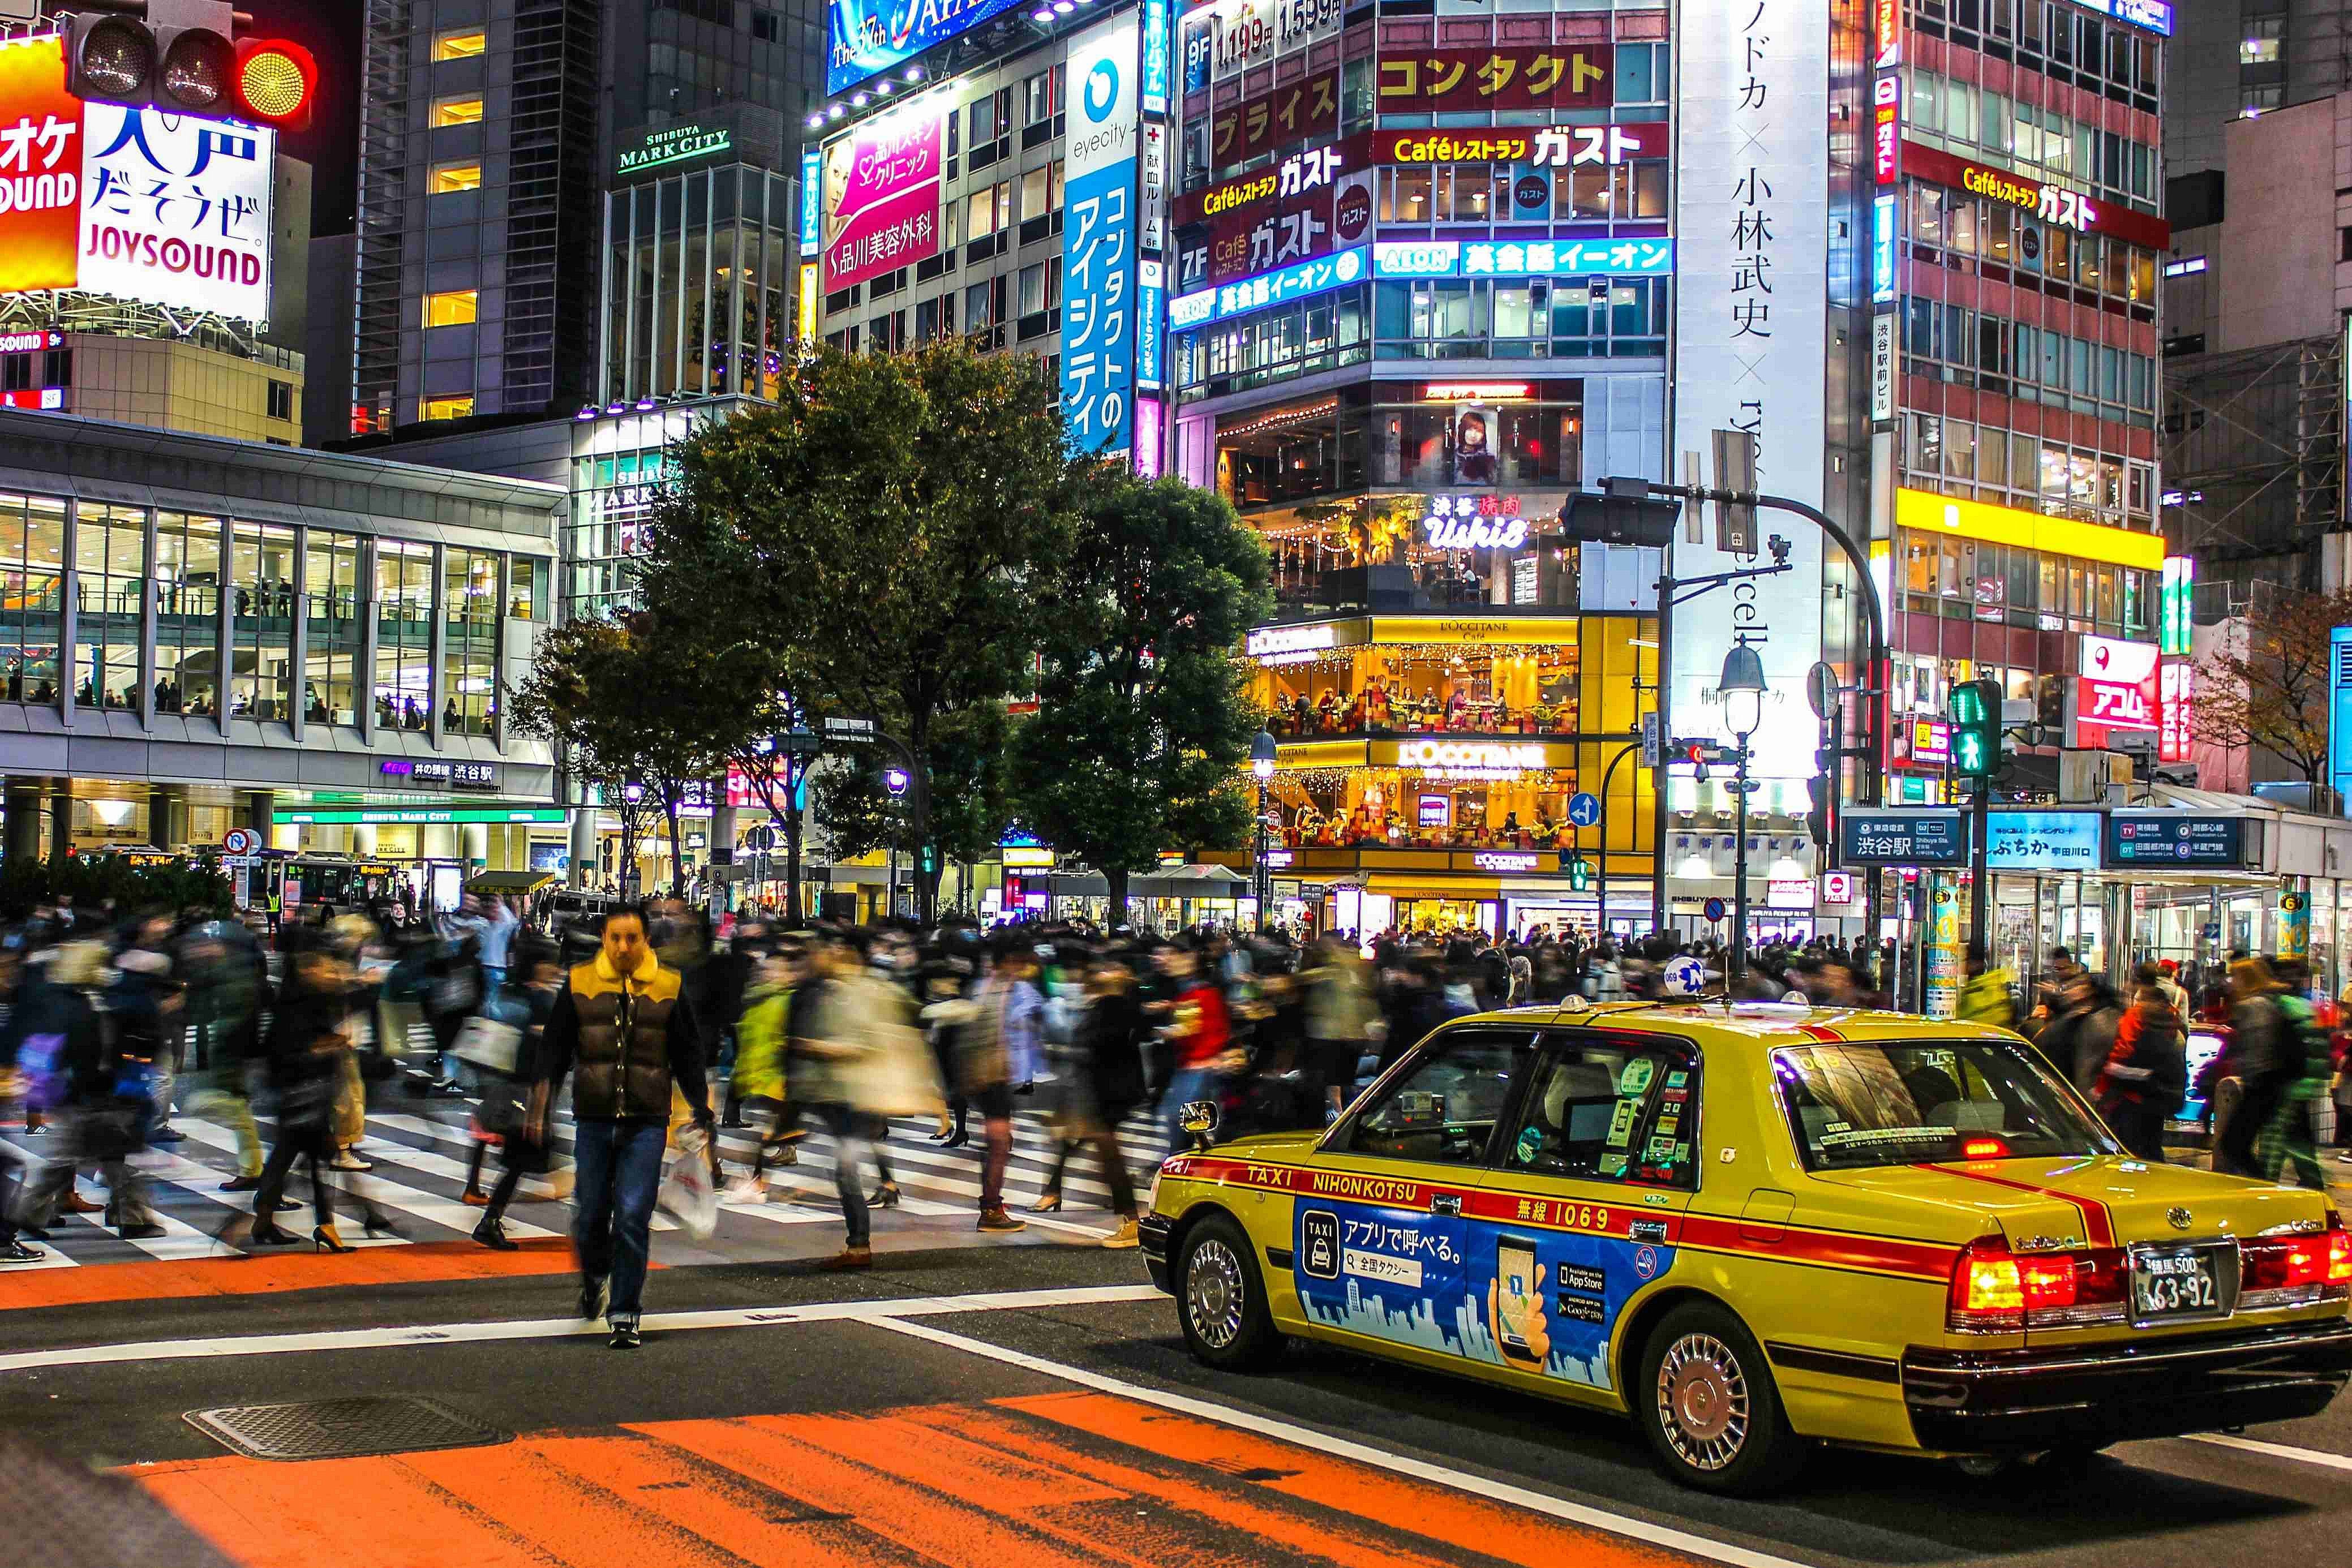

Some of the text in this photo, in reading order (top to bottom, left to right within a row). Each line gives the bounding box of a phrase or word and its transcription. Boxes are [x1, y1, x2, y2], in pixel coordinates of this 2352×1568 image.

[834, 44, 857, 68] The
[856, 15, 886, 55] 37th
[1188, 36, 1210, 66] 9F
[1380, 53, 1605, 97] コンタクト
[1216, 77, 1336, 155] プライス
[0, 115, 76, 172] オケ
[620, 130, 728, 169] MARK CITY
[646, 125, 699, 145] SHIBUYA
[1074, 123, 1126, 161] eyecity
[1533, 126, 1641, 167] ガスト
[1878, 122, 1892, 175] ガスト
[875, 148, 928, 190] クリニック
[1280, 144, 1342, 199] ガスト
[90, 166, 263, 247] だそうぜ。
[1146, 154, 1160, 233] 献血ルーム
[1519, 190, 1544, 200] ガスト
[2038, 184, 2096, 233] ガスト
[1342, 208, 1367, 226] ガスト
[87, 224, 261, 286] JOYSOUND
[840, 210, 933, 276] 品川美容外科
[1146, 238, 1157, 247] 6F
[1216, 234, 1247, 261] Café
[1250, 209, 1325, 273] ガスト
[1730, 167, 1772, 338] 小林武史
[1182, 247, 1208, 281] 7F
[1215, 259, 1246, 277] レストラン
[1384, 248, 1448, 269] AEON
[1466, 243, 1667, 273] 英会話イーオン
[1220, 263, 1332, 315] 英会話イーオン
[1068, 198, 1101, 435] アイシティ
[1104, 187, 1126, 428] コンタクトの
[1876, 324, 1889, 411] 渋谷駅前ビル
[1479, 497, 1521, 517] 焼肉
[1423, 516, 1528, 549] Ushi8
[1440, 620, 1509, 632] L'OCCITANE
[2093, 684, 2144, 719] アコム
[415, 763, 450, 776] 井の頭線
[454, 764, 492, 780] 渋谷駅
[362, 812, 452, 821] SHIBUYA MARK CITY
[1873, 823, 1905, 833] 東急電鉄
[2192, 824, 2224, 832] 副都心線
[1475, 853, 1537, 866] L'OCCITANE
[1857, 836, 1911, 856] 渋谷駅
[1987, 839, 2049, 856] ぶちか
[2051, 847, 2090, 857] 宇田川口
[2135, 843, 2174, 851] 田園都市線
[2192, 843, 2224, 852] 半蔵門線
[1247, 1166, 1292, 1187] TAXI
[1308, 1222, 1332, 1237] TAXI
[1517, 1198, 1608, 1230] 無線 1069
[1345, 1219, 1460, 1264] アプリで呼べる。
[1360, 1257, 1409, 1276] 全国タクシー
[2175, 1257, 2196, 1273] 500
[1569, 1273, 1602, 1290] App Store
[2154, 1277, 2214, 1311] 63-92
[1567, 1304, 1590, 1319] Google
